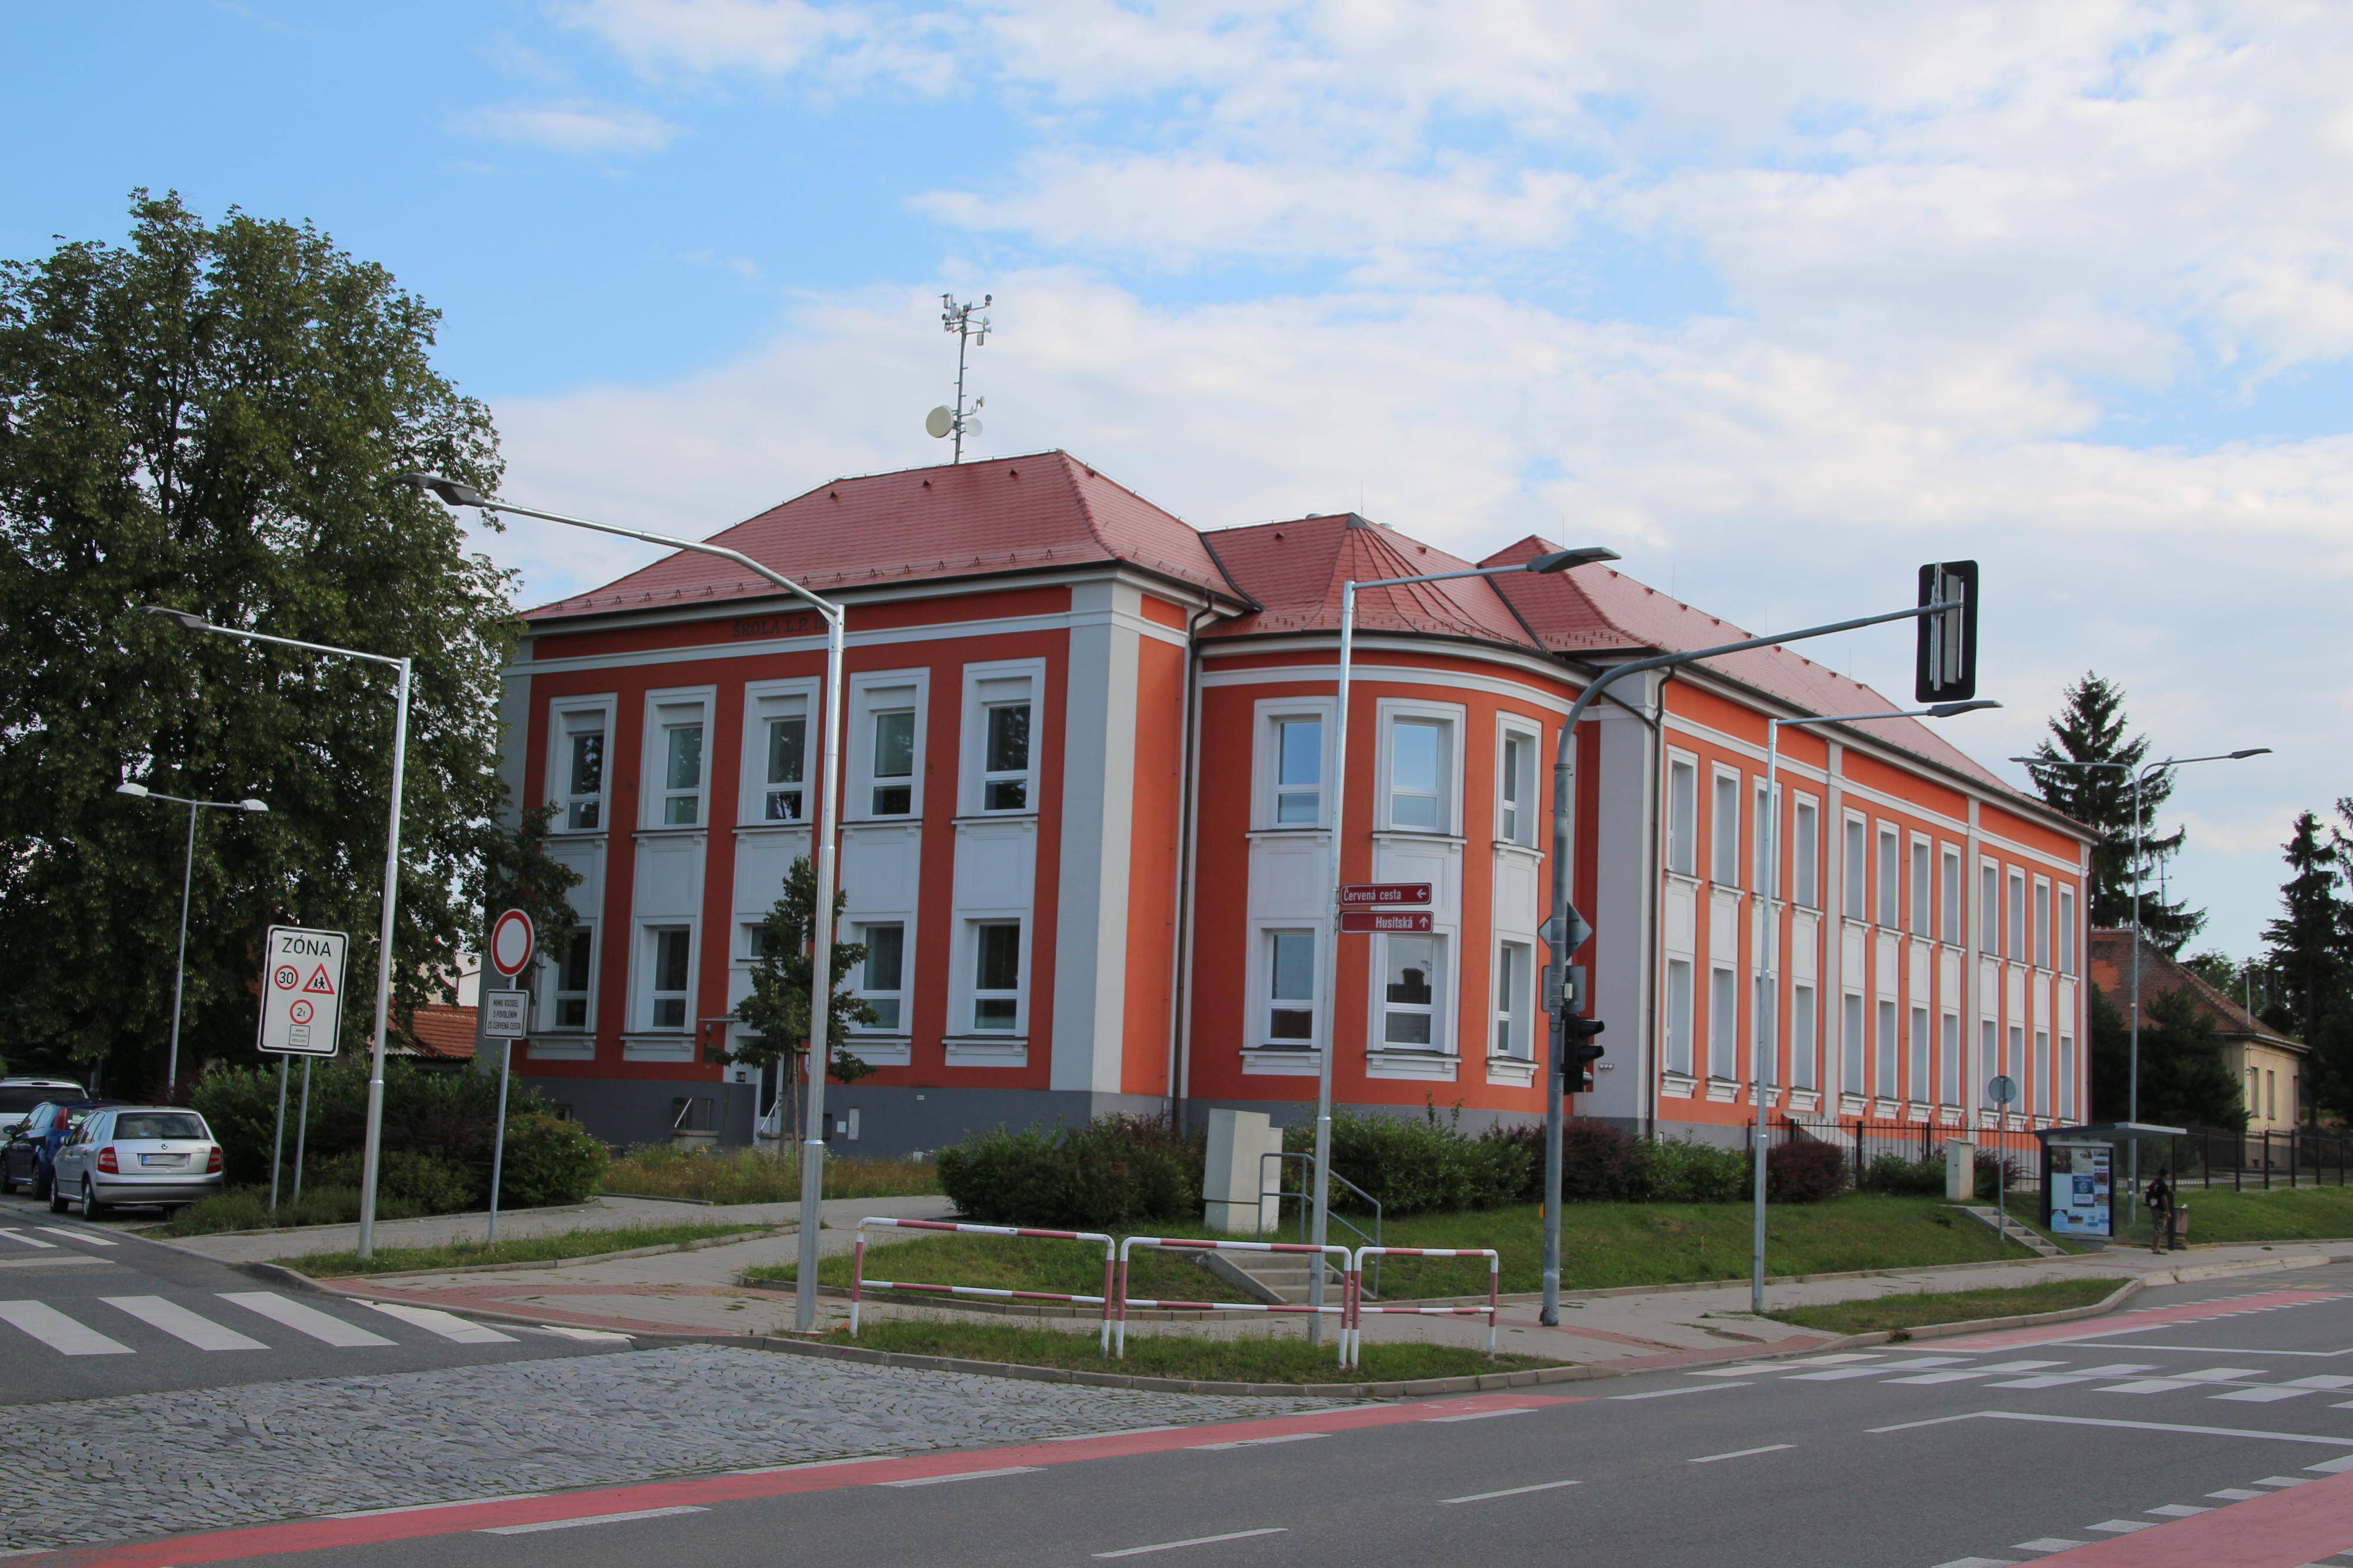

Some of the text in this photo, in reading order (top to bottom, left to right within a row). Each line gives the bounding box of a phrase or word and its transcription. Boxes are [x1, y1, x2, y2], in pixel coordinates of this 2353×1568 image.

[1344, 887, 1401, 901] Červená cesta
[1375, 916, 1413, 929] Husitská
[282, 935, 331, 958] ZÓNA
[279, 971, 294, 985] 30
[493, 999, 504, 1007] MIMO
[493, 1020, 509, 1029] ČERVENÁ
